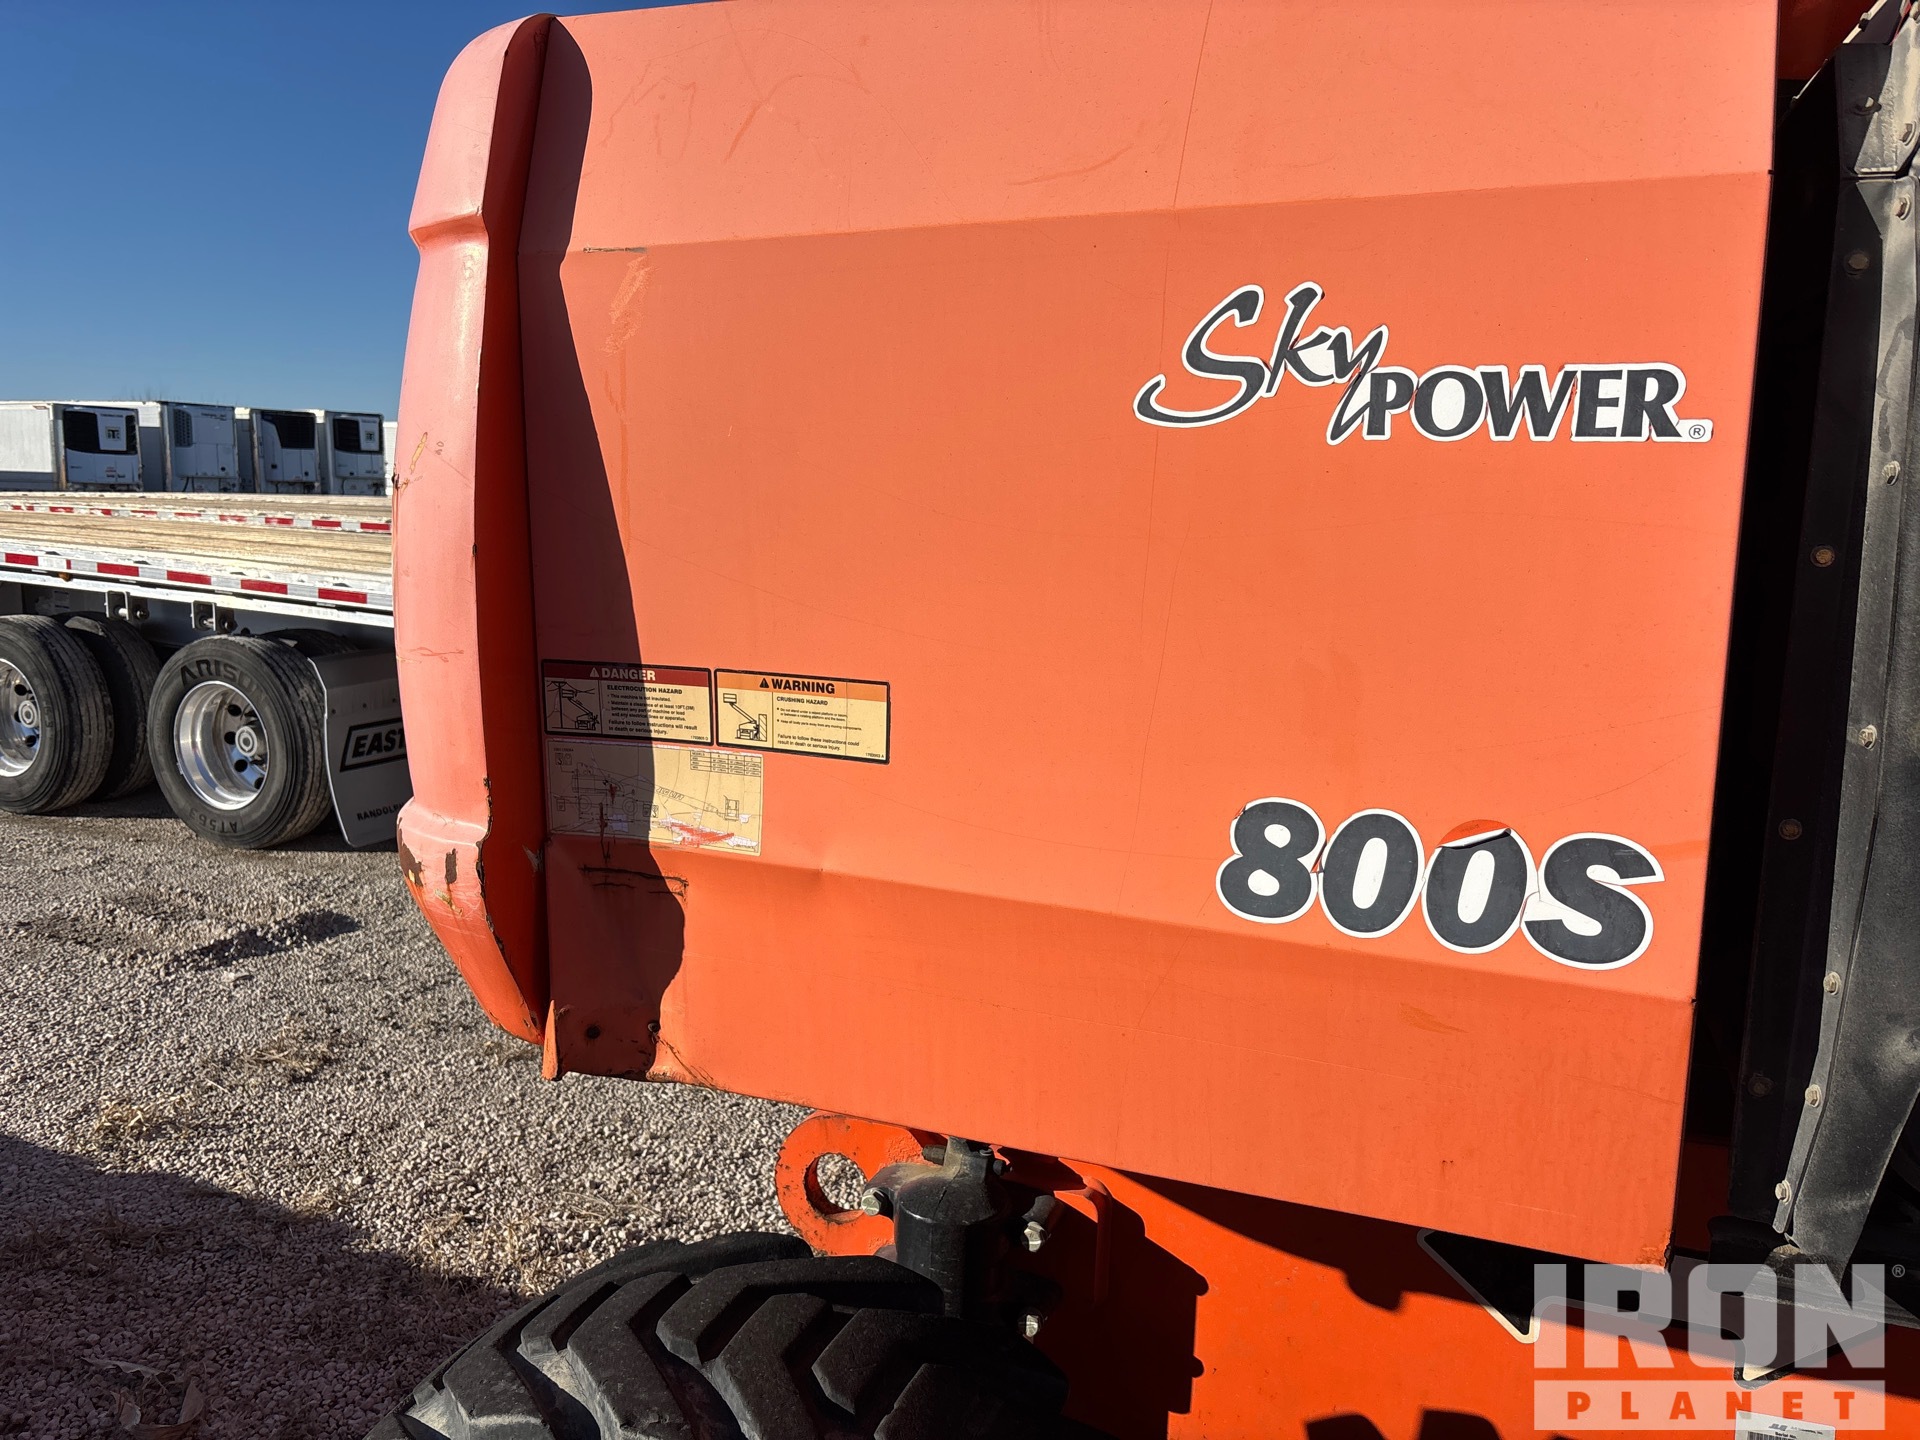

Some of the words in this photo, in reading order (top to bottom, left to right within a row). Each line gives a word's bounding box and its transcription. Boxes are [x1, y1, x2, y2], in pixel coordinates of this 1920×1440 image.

[1134, 283, 1388, 445] Sky
[601, 667, 656, 681] DANGER
[607, 684, 657, 692] ELECTROCUTION
[771, 678, 835, 694] WARNING
[1217, 798, 1661, 969] 800S
